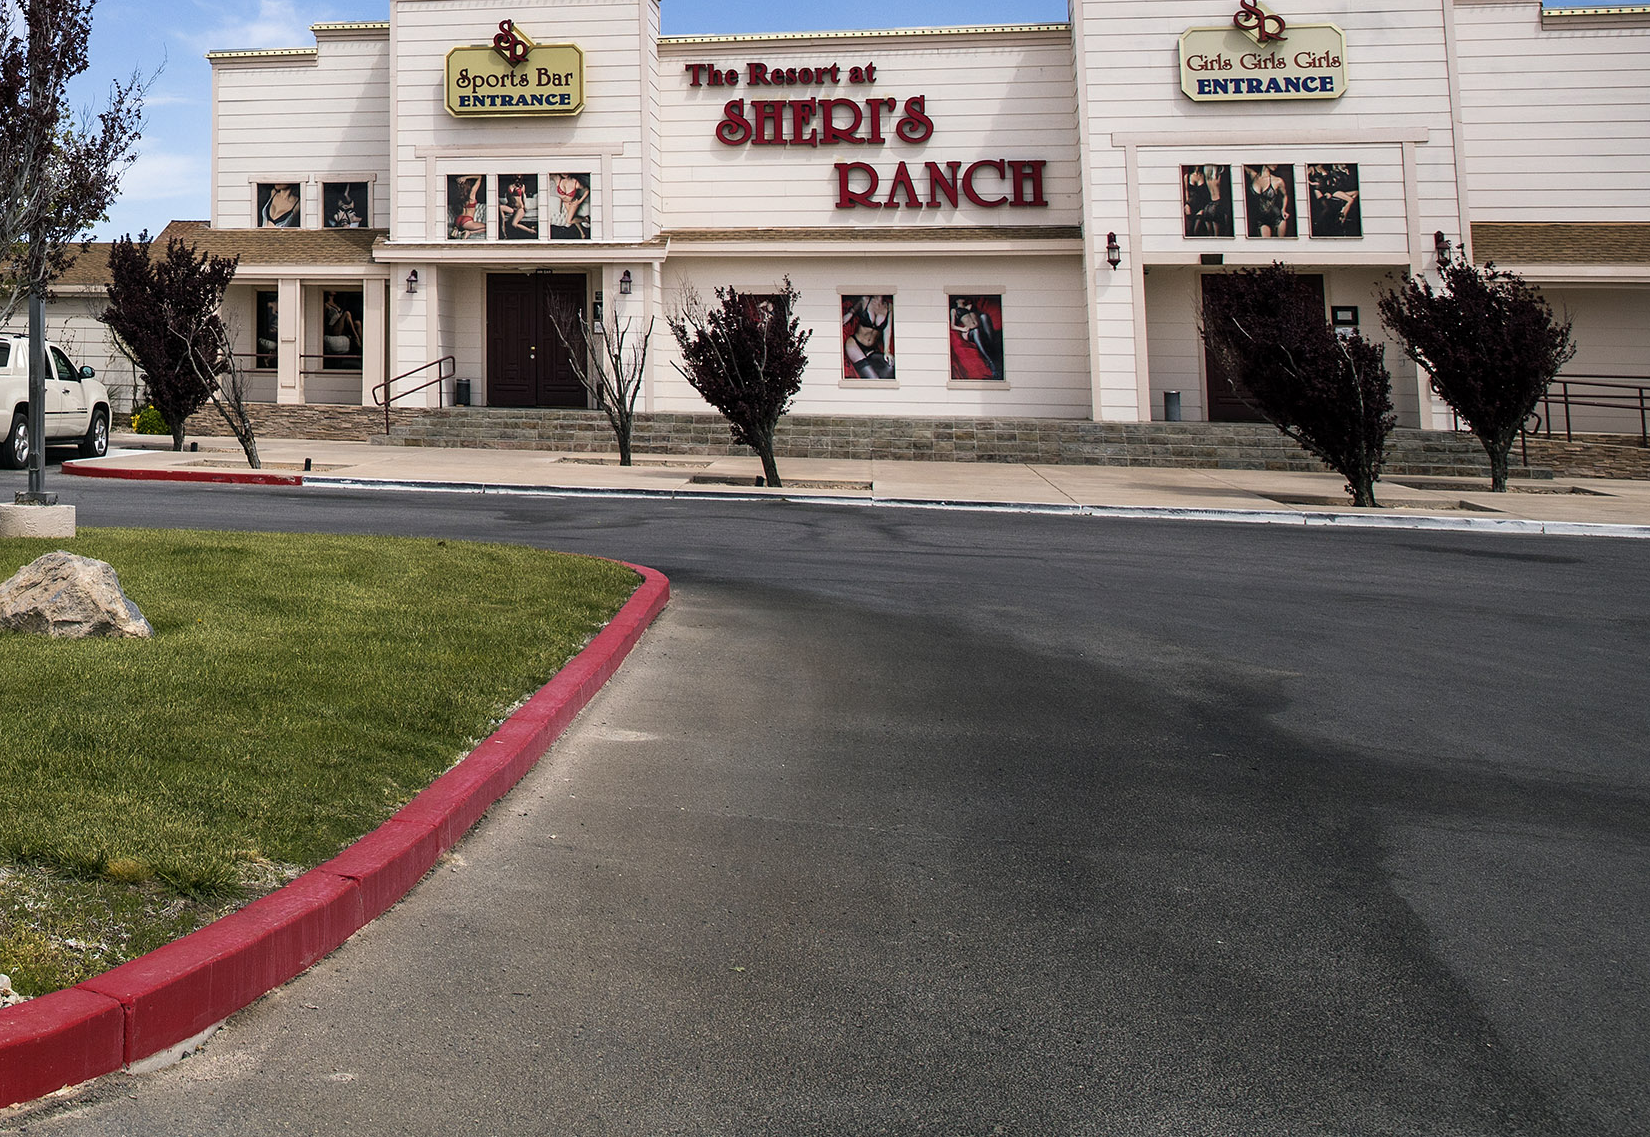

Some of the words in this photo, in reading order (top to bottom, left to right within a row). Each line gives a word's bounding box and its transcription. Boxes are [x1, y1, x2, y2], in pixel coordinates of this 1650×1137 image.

[685, 63, 739, 87] The
[747, 62, 841, 86] Resort
[849, 61, 877, 84] at
[1186, 53, 1233, 72] Girls
[1239, 51, 1287, 70] Girls
[1294, 50, 1342, 69] Girls
[456, 67, 530, 94] Sports
[535, 67, 574, 88] Bar
[1196, 75, 1335, 95] ENTRANCE
[458, 93, 571, 108] ENTRANCE
[715, 94, 934, 148] SHERI'S
[834, 159, 1049, 209] RANCH
